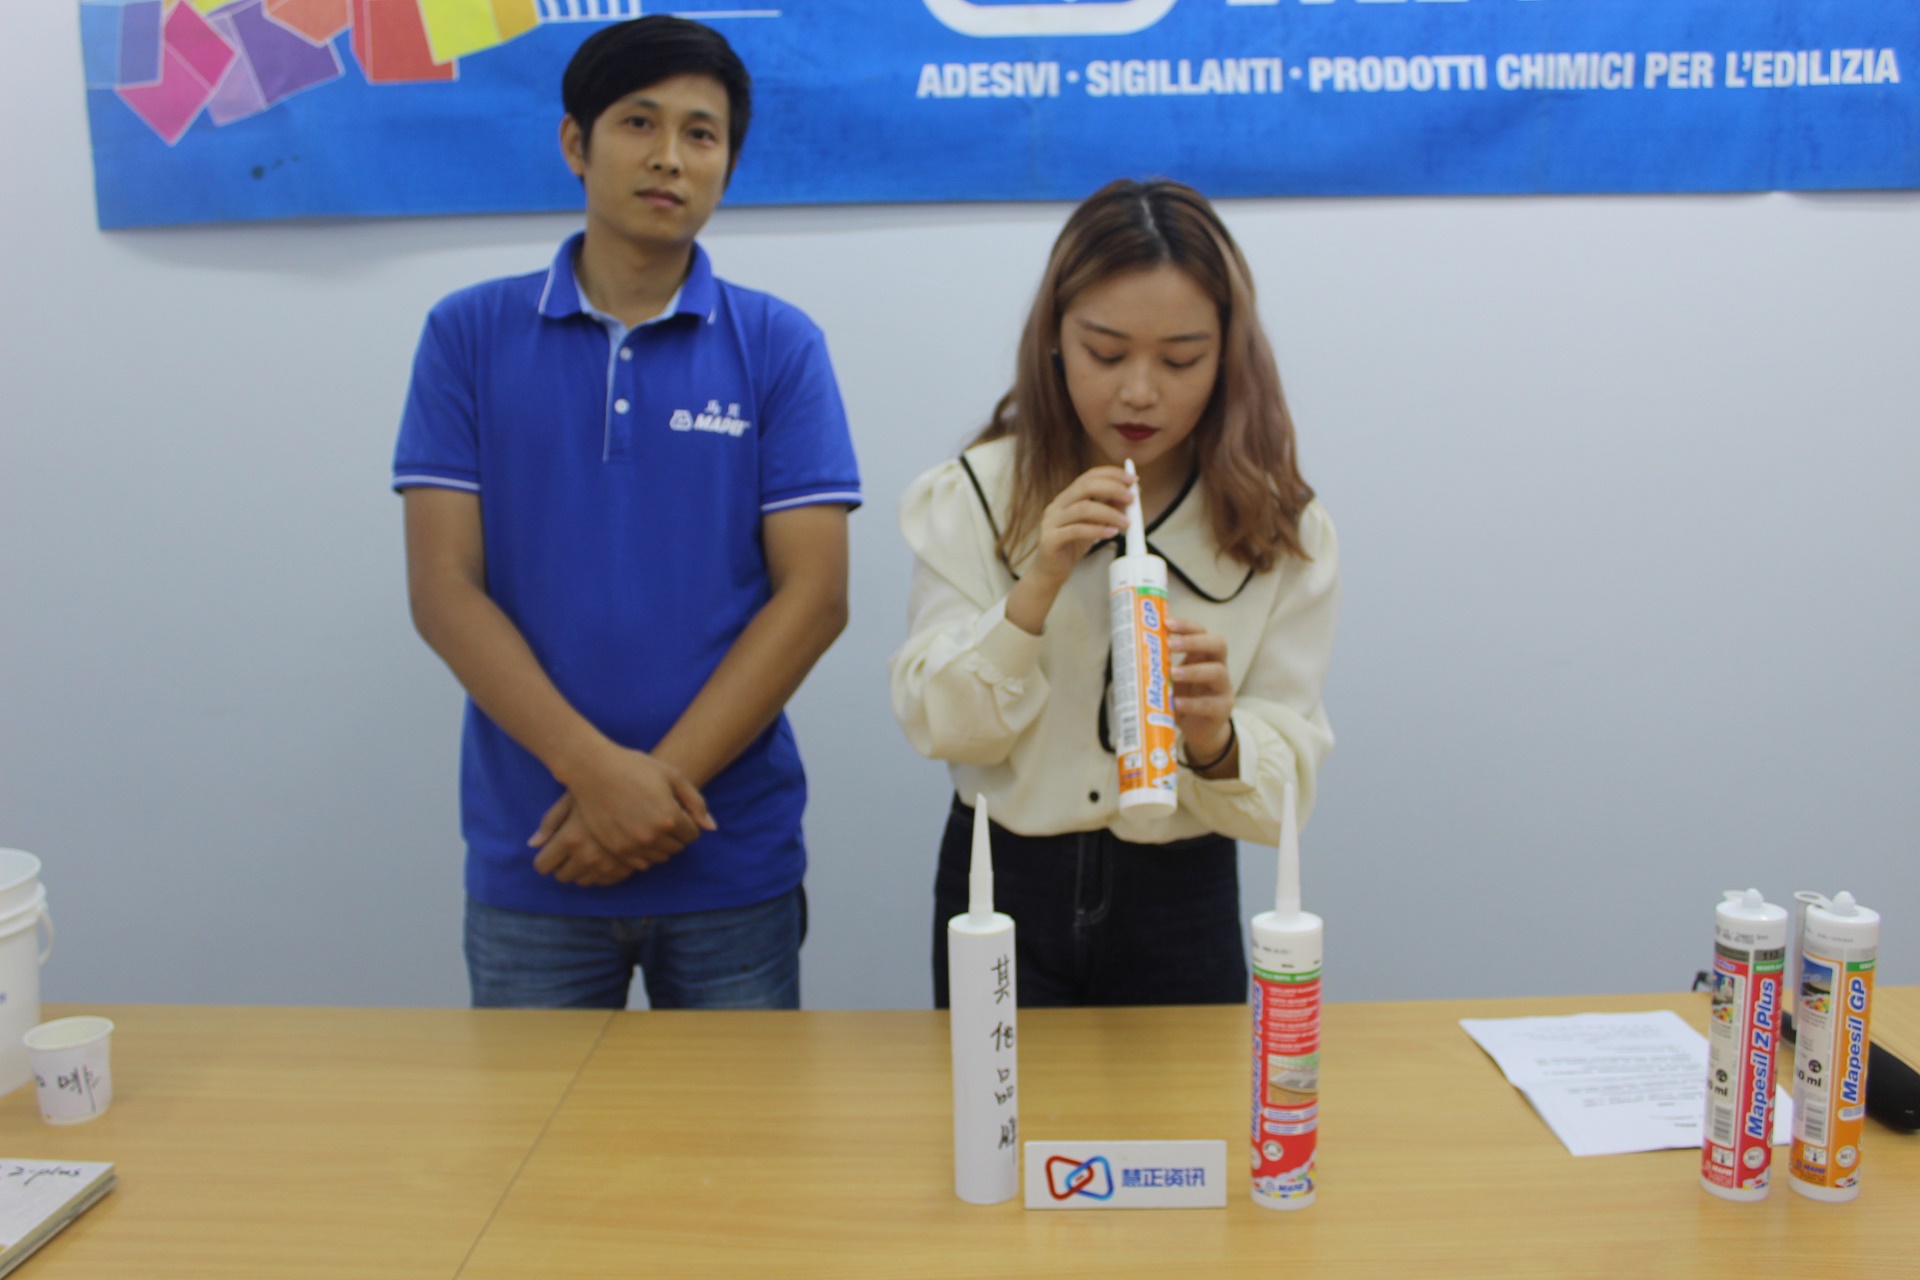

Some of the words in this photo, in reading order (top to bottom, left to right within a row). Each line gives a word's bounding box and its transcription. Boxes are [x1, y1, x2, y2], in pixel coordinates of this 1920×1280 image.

[916, 62, 1060, 99] ADESIVI
[1084, 57, 1284, 97] SIGILLANTI
[1308, 54, 1487, 92] PRODOTTI
[1496, 52, 1635, 90] CHIMICI
[1643, 51, 1715, 89] PER
[1143, 600, 1158, 628] GP
[1145, 632, 1163, 709] Mapesil
[1757, 980, 1774, 1027] Plus
[1849, 978, 1865, 1011] GP
[1755, 1030, 1770, 1049] Z
[1842, 1015, 1863, 1102] Mapesil
[1715, 1085, 1729, 1097] ml
[1747, 1051, 1769, 1137] Mapesil
[1806, 1075, 1822, 1088] ml
[1122, 1167, 1205, 1188] 慧正资讯
